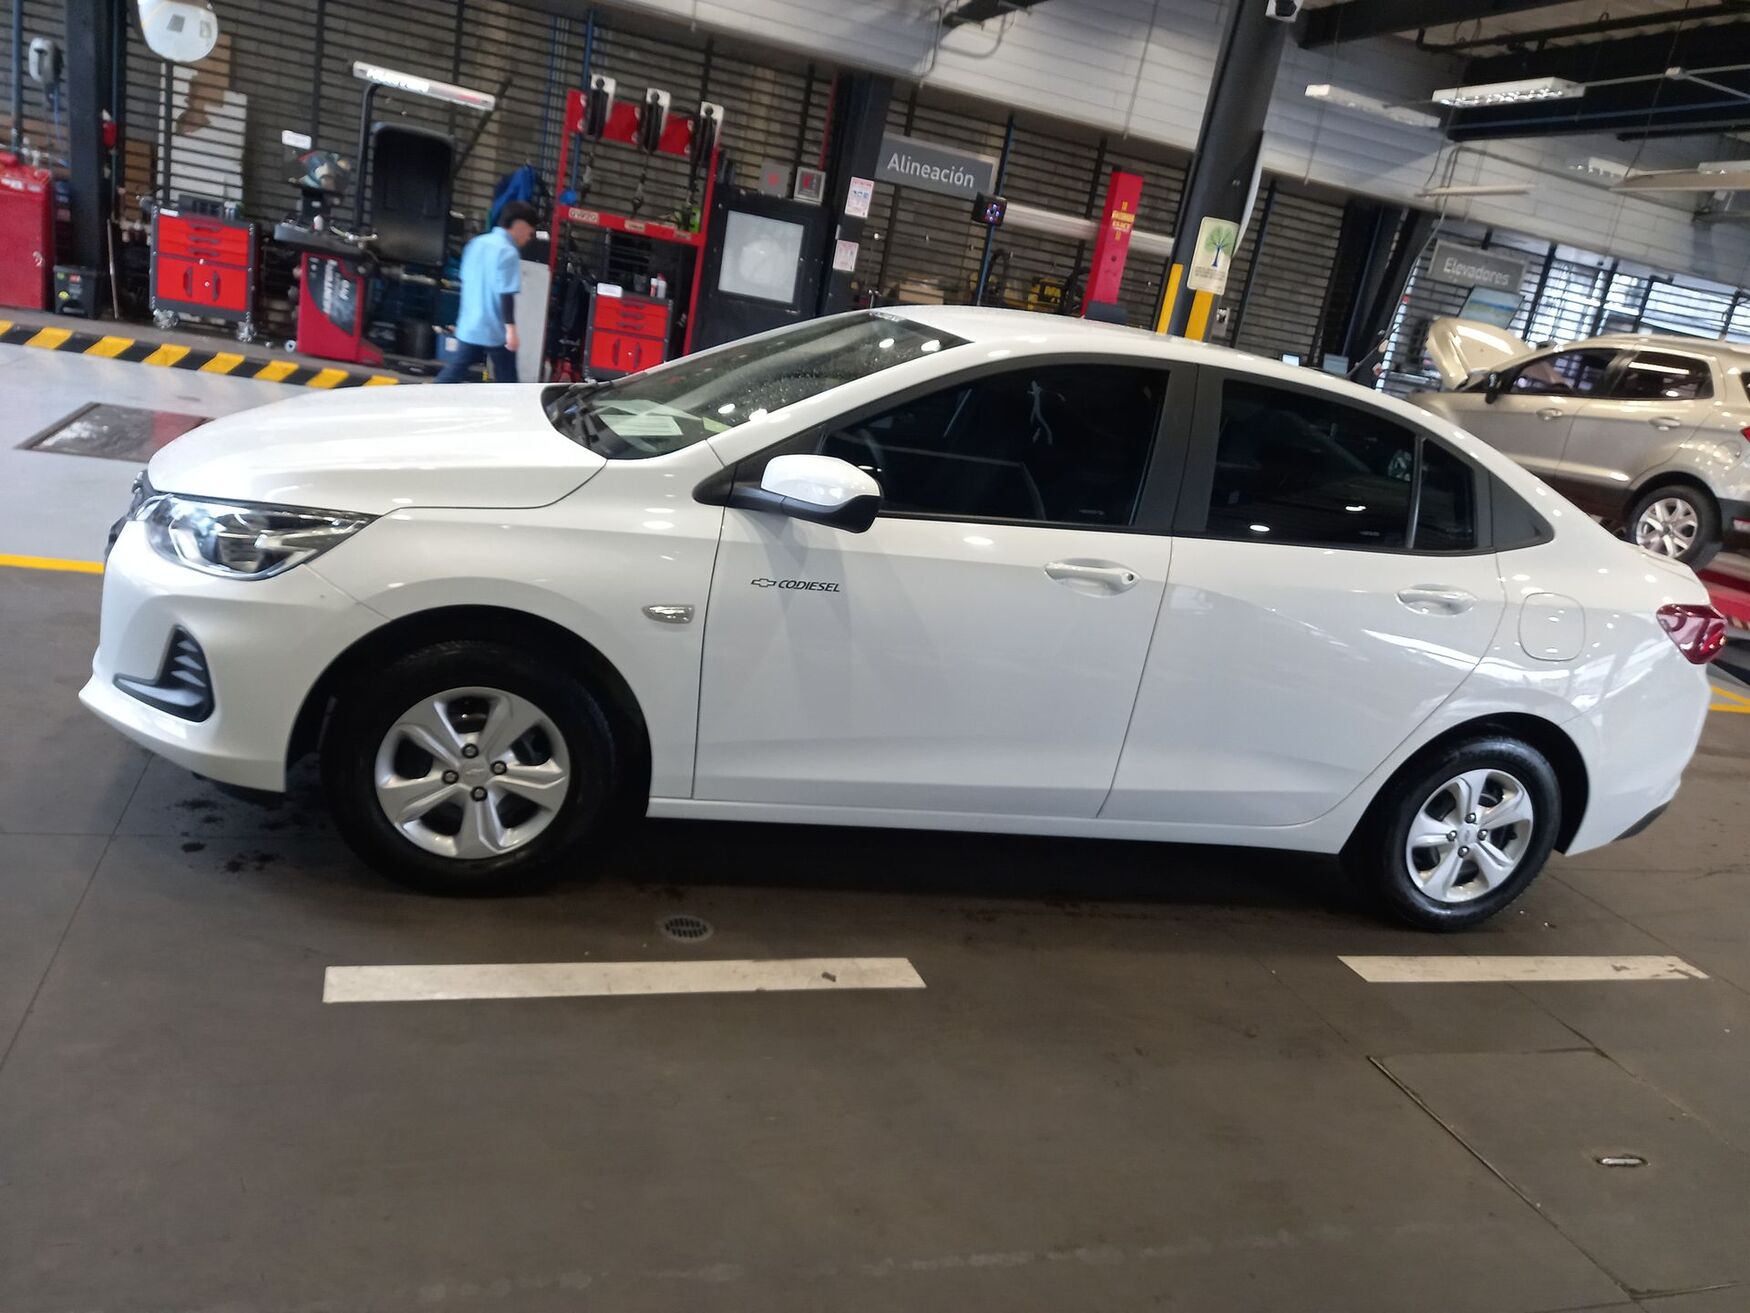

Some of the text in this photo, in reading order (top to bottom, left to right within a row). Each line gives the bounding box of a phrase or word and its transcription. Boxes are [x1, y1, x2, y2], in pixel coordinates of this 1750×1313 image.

[887, 153, 975, 187] Alineación
[1444, 257, 1509, 285] Elevadores
[778, 580, 840, 592] CODIESEL
